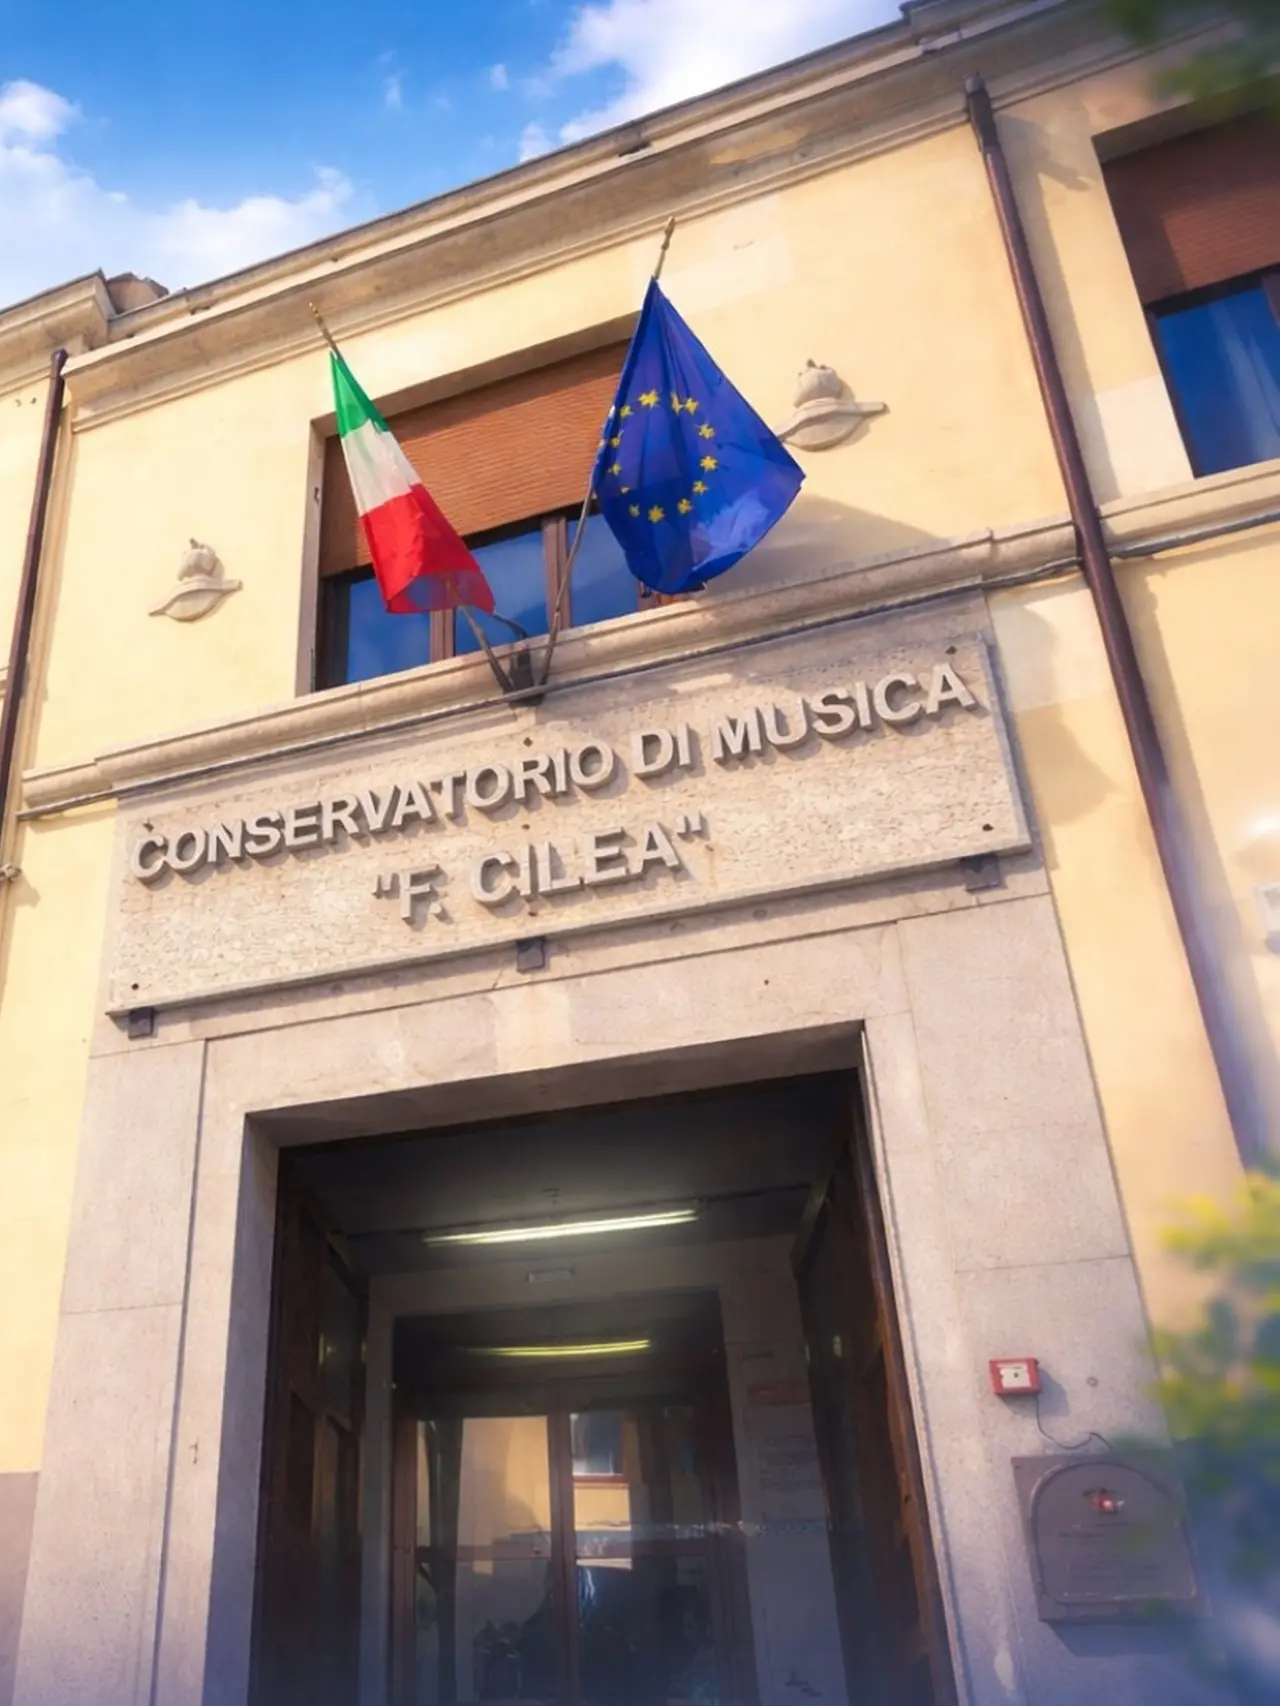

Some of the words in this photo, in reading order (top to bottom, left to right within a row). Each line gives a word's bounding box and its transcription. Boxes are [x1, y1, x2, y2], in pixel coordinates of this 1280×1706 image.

[129, 742, 615, 880] CONSERVATORIO
[631, 722, 693, 778] DI
[710, 662, 976, 763] MUSICA
[371, 863, 443, 921] "F.
[471, 812, 703, 906] CILEA"
